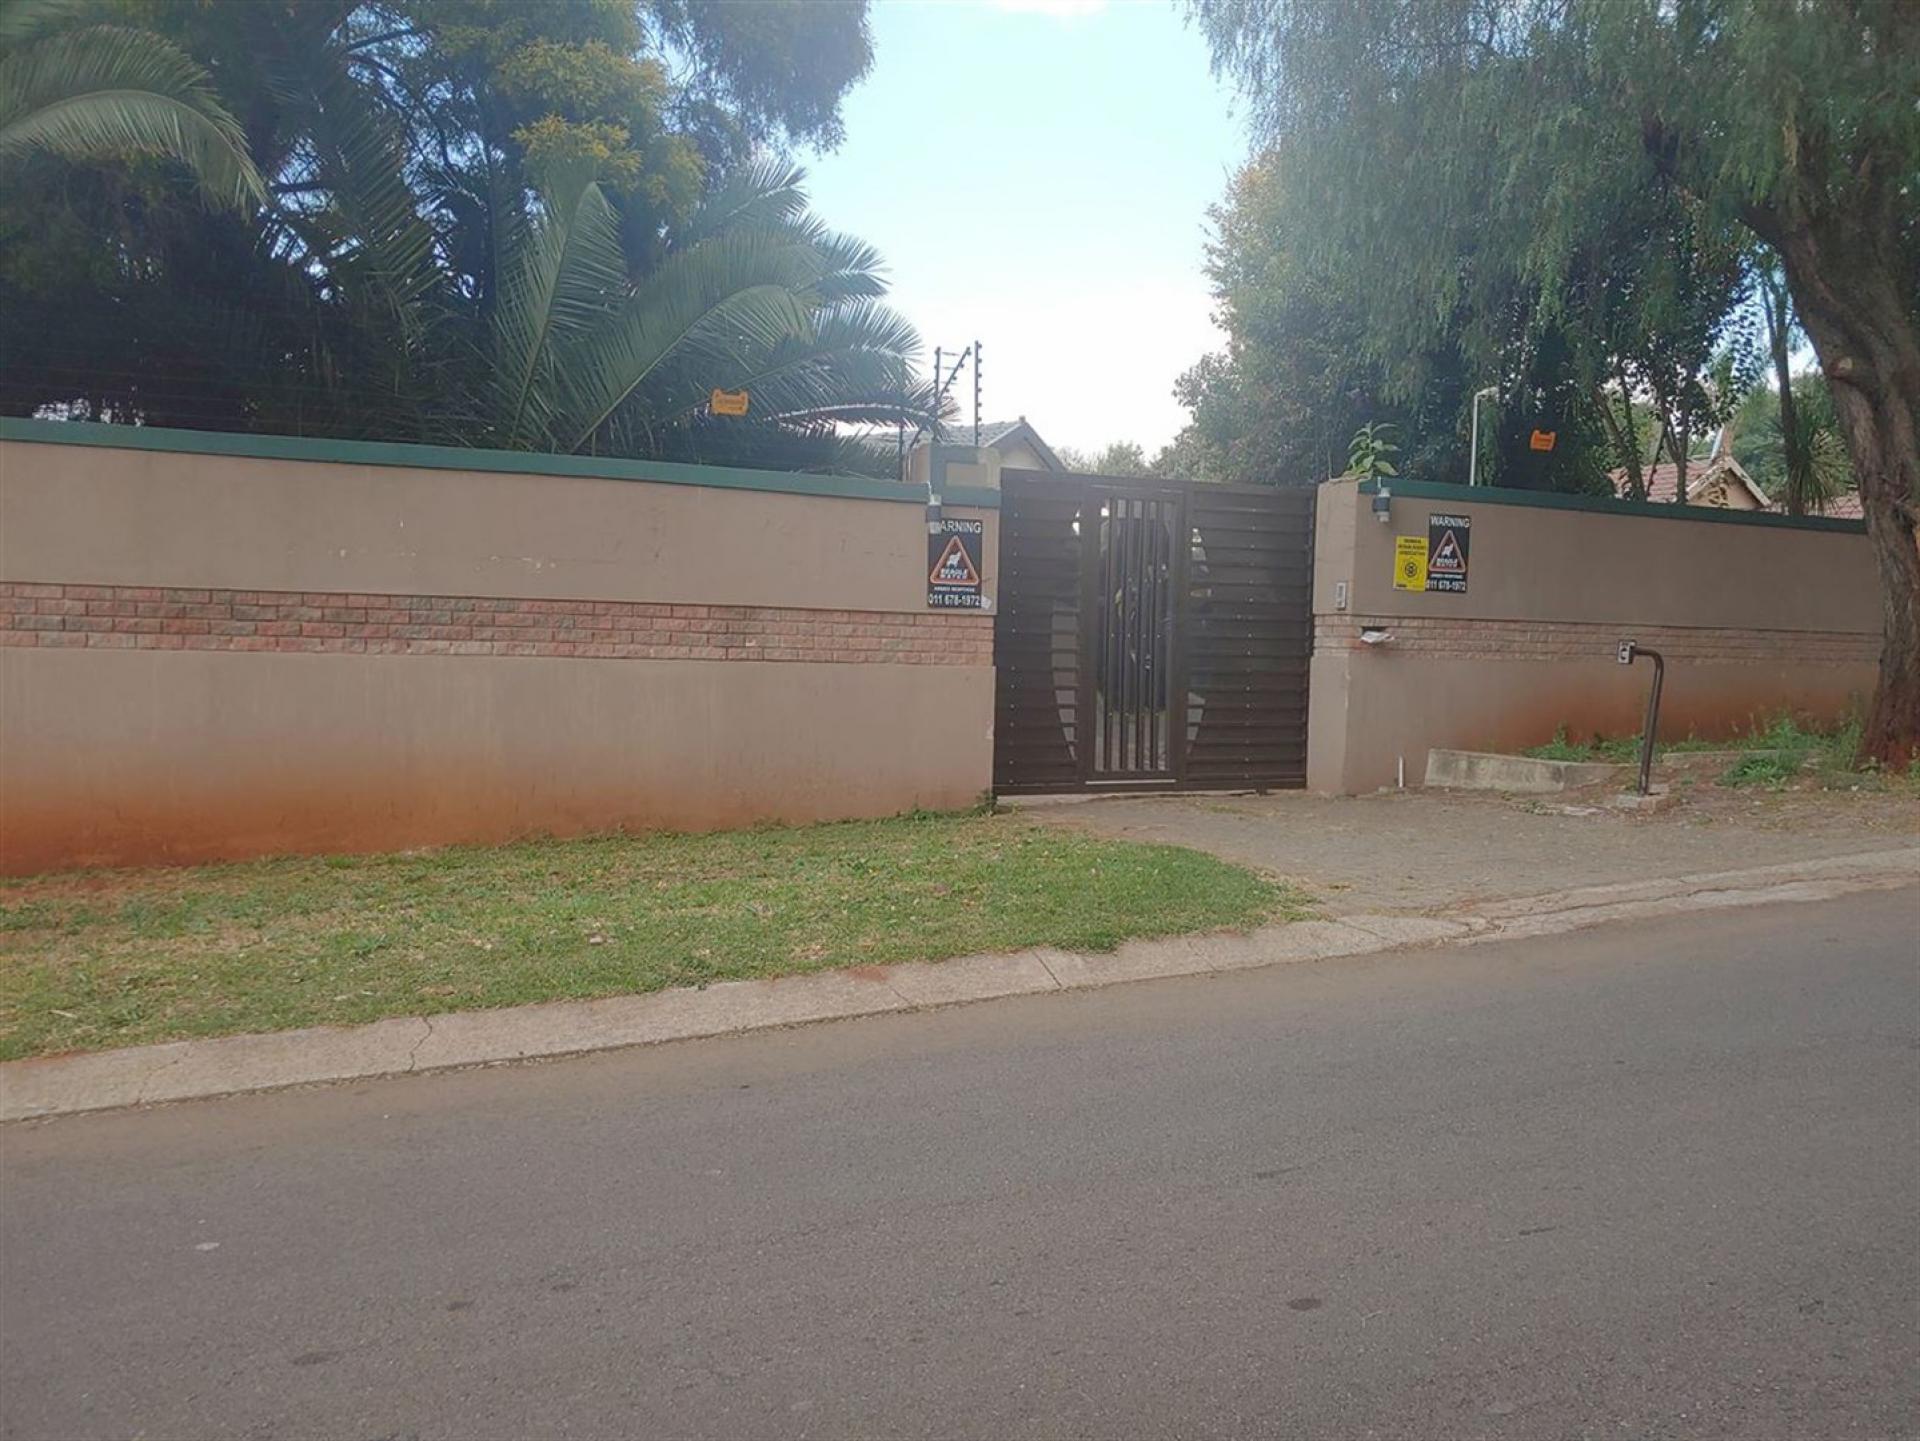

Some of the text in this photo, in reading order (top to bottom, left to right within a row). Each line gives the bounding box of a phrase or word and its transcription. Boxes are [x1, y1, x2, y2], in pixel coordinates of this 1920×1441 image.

[940, 520, 982, 533] ARNING
[1430, 515, 1470, 528] WARNING
[928, 593, 943, 605] 011
